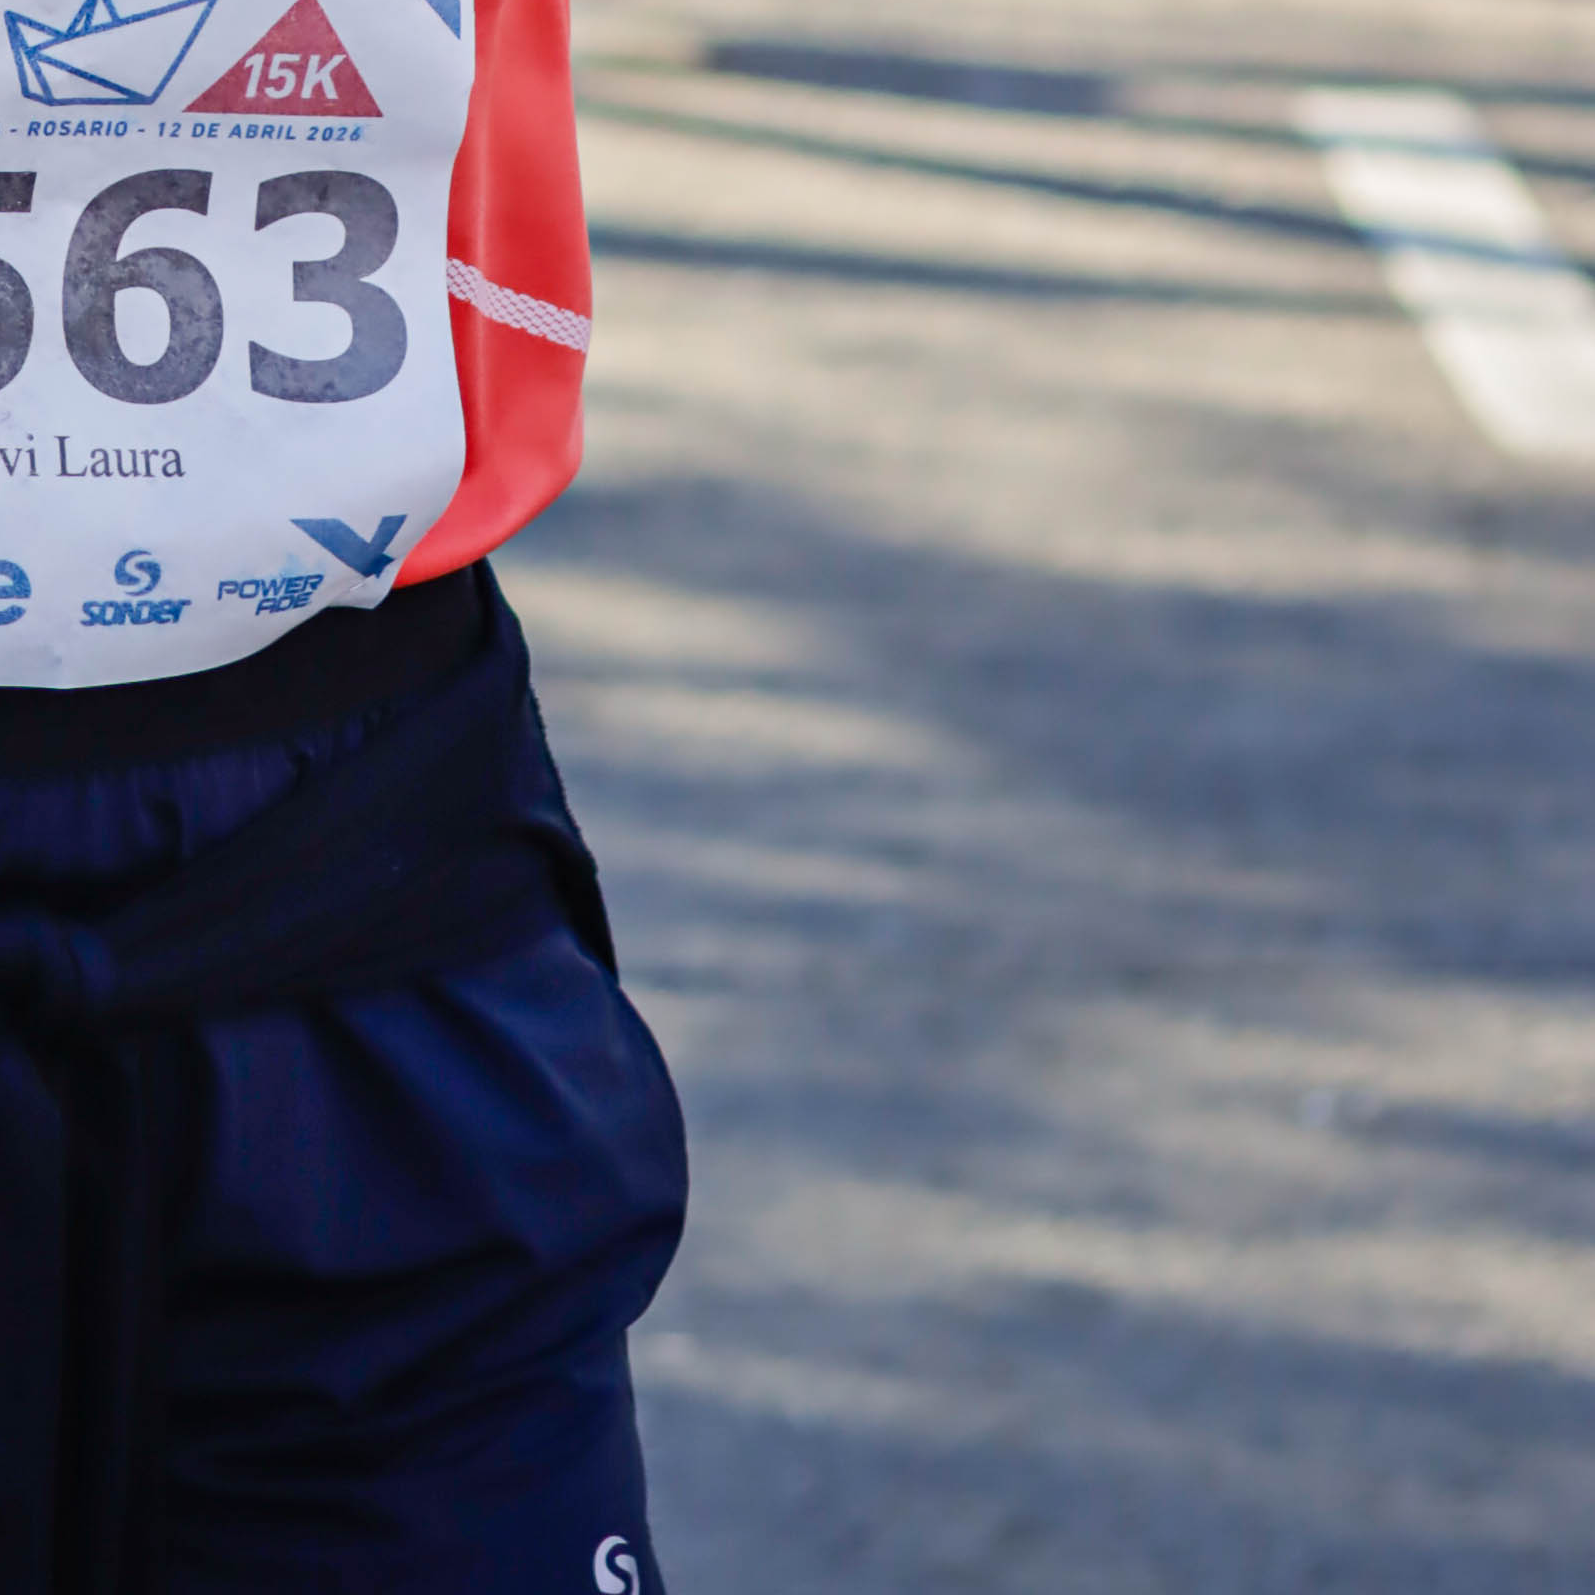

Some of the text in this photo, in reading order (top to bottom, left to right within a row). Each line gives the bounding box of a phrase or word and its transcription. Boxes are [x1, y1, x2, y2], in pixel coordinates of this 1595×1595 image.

[242, 53, 347, 101] 15K
[26, 120, 129, 138] ROSARIO
[158, 121, 181, 138] 12
[191, 123, 221, 140] DE
[228, 123, 297, 141] ABRIL
[306, 125, 363, 142] 2026
[53, 434, 186, 478] Laura
[217, 574, 325, 601] POWER
[255, 591, 315, 616] ADE
